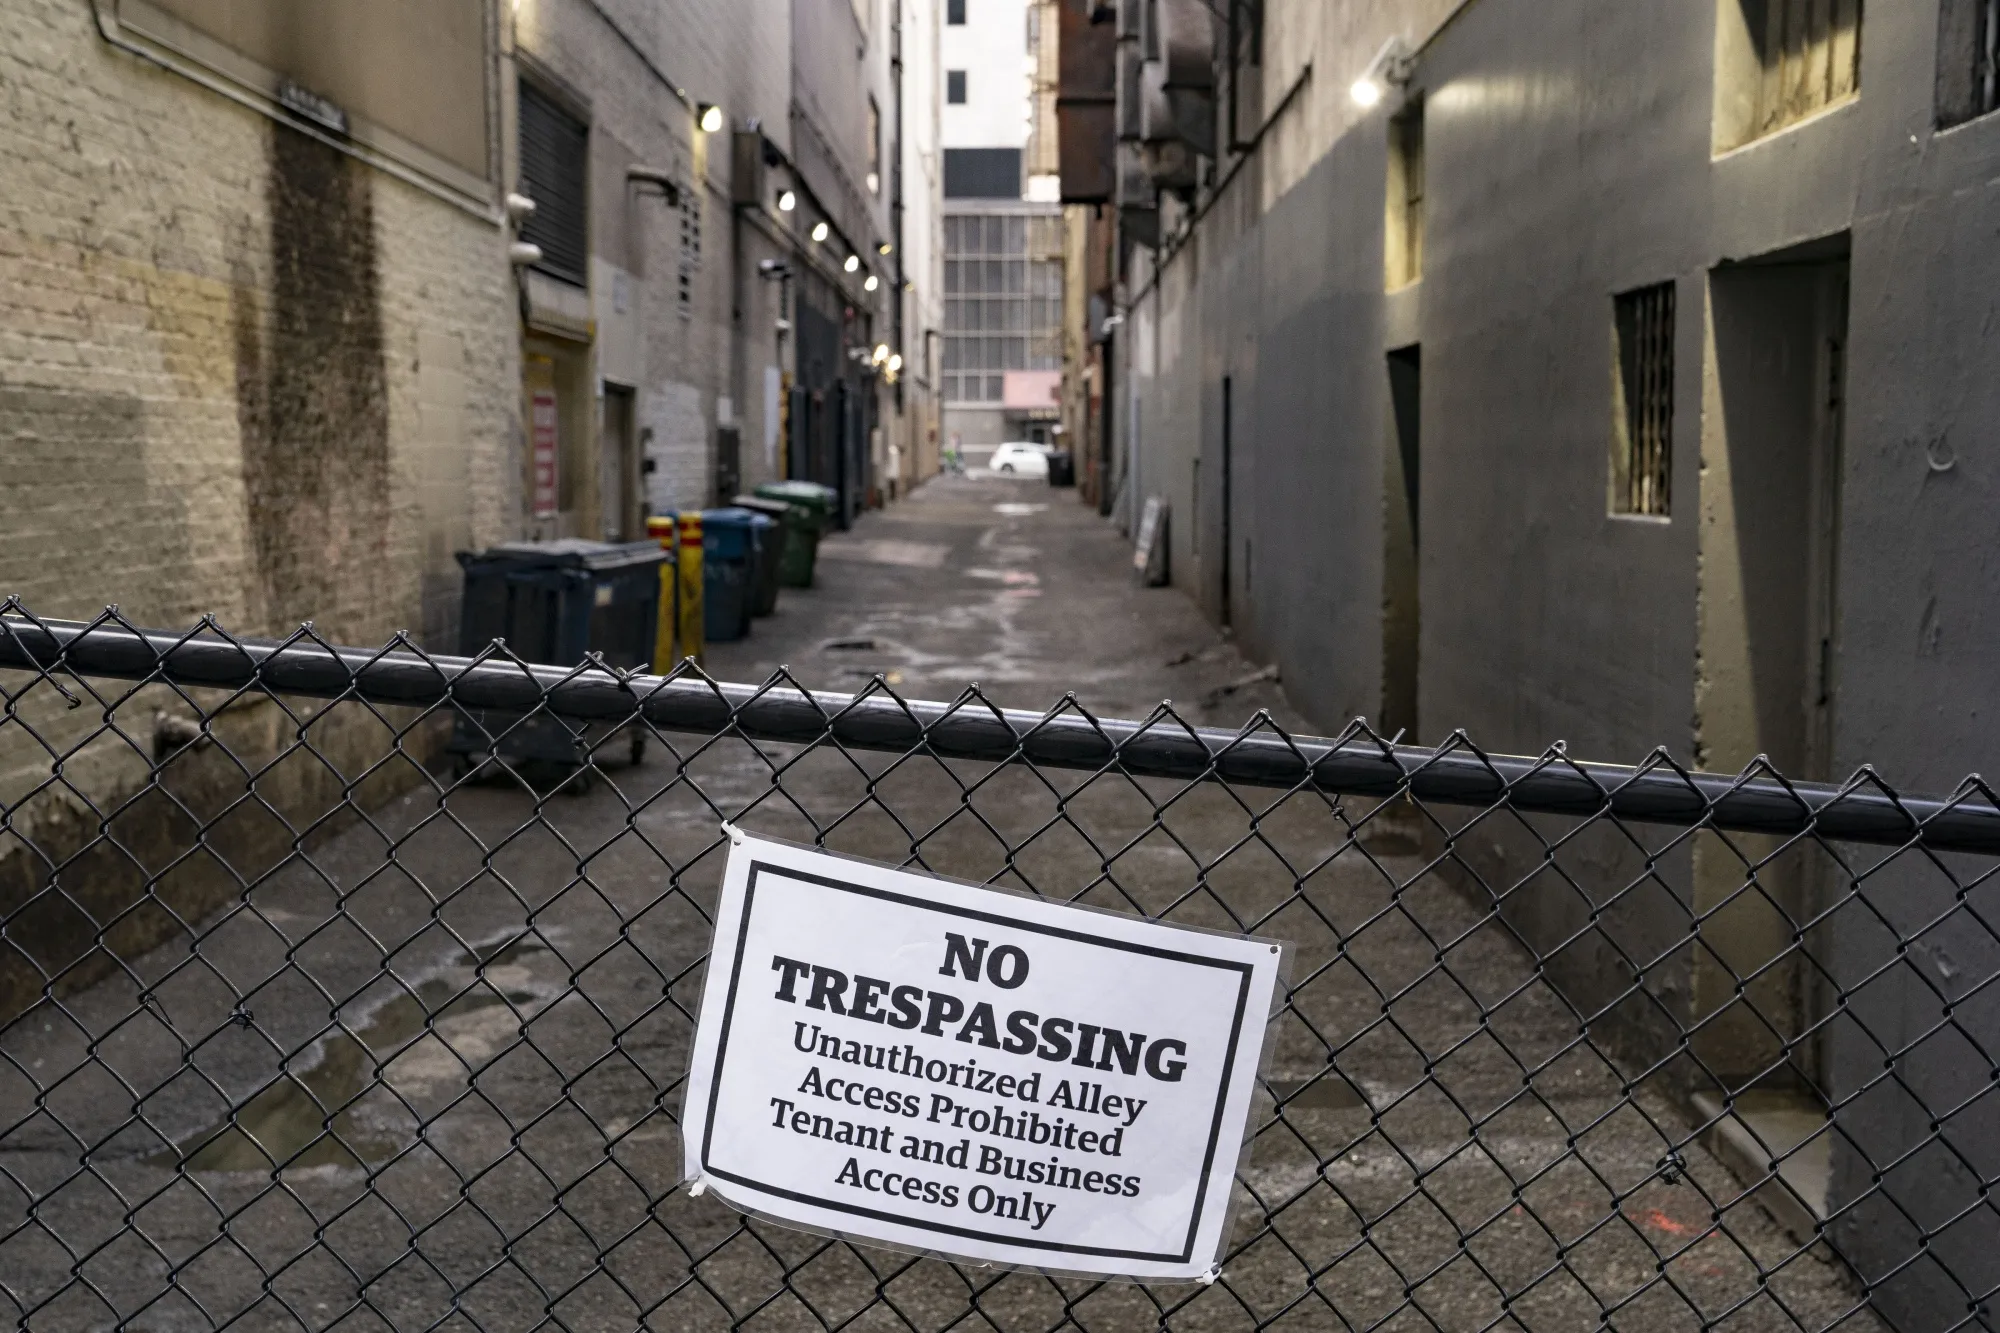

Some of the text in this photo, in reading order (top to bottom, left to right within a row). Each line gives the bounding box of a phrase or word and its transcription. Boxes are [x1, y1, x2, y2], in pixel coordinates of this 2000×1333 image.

[939, 932, 1029, 989] NO
[772, 955, 1187, 1082] TRESPASSING
[795, 1021, 1147, 1126] Unauthorized Alley
[798, 1067, 1123, 1156] Access Prohibited
[771, 1098, 1140, 1197] Tenant and Business
[835, 1158, 1056, 1230] Access Only
